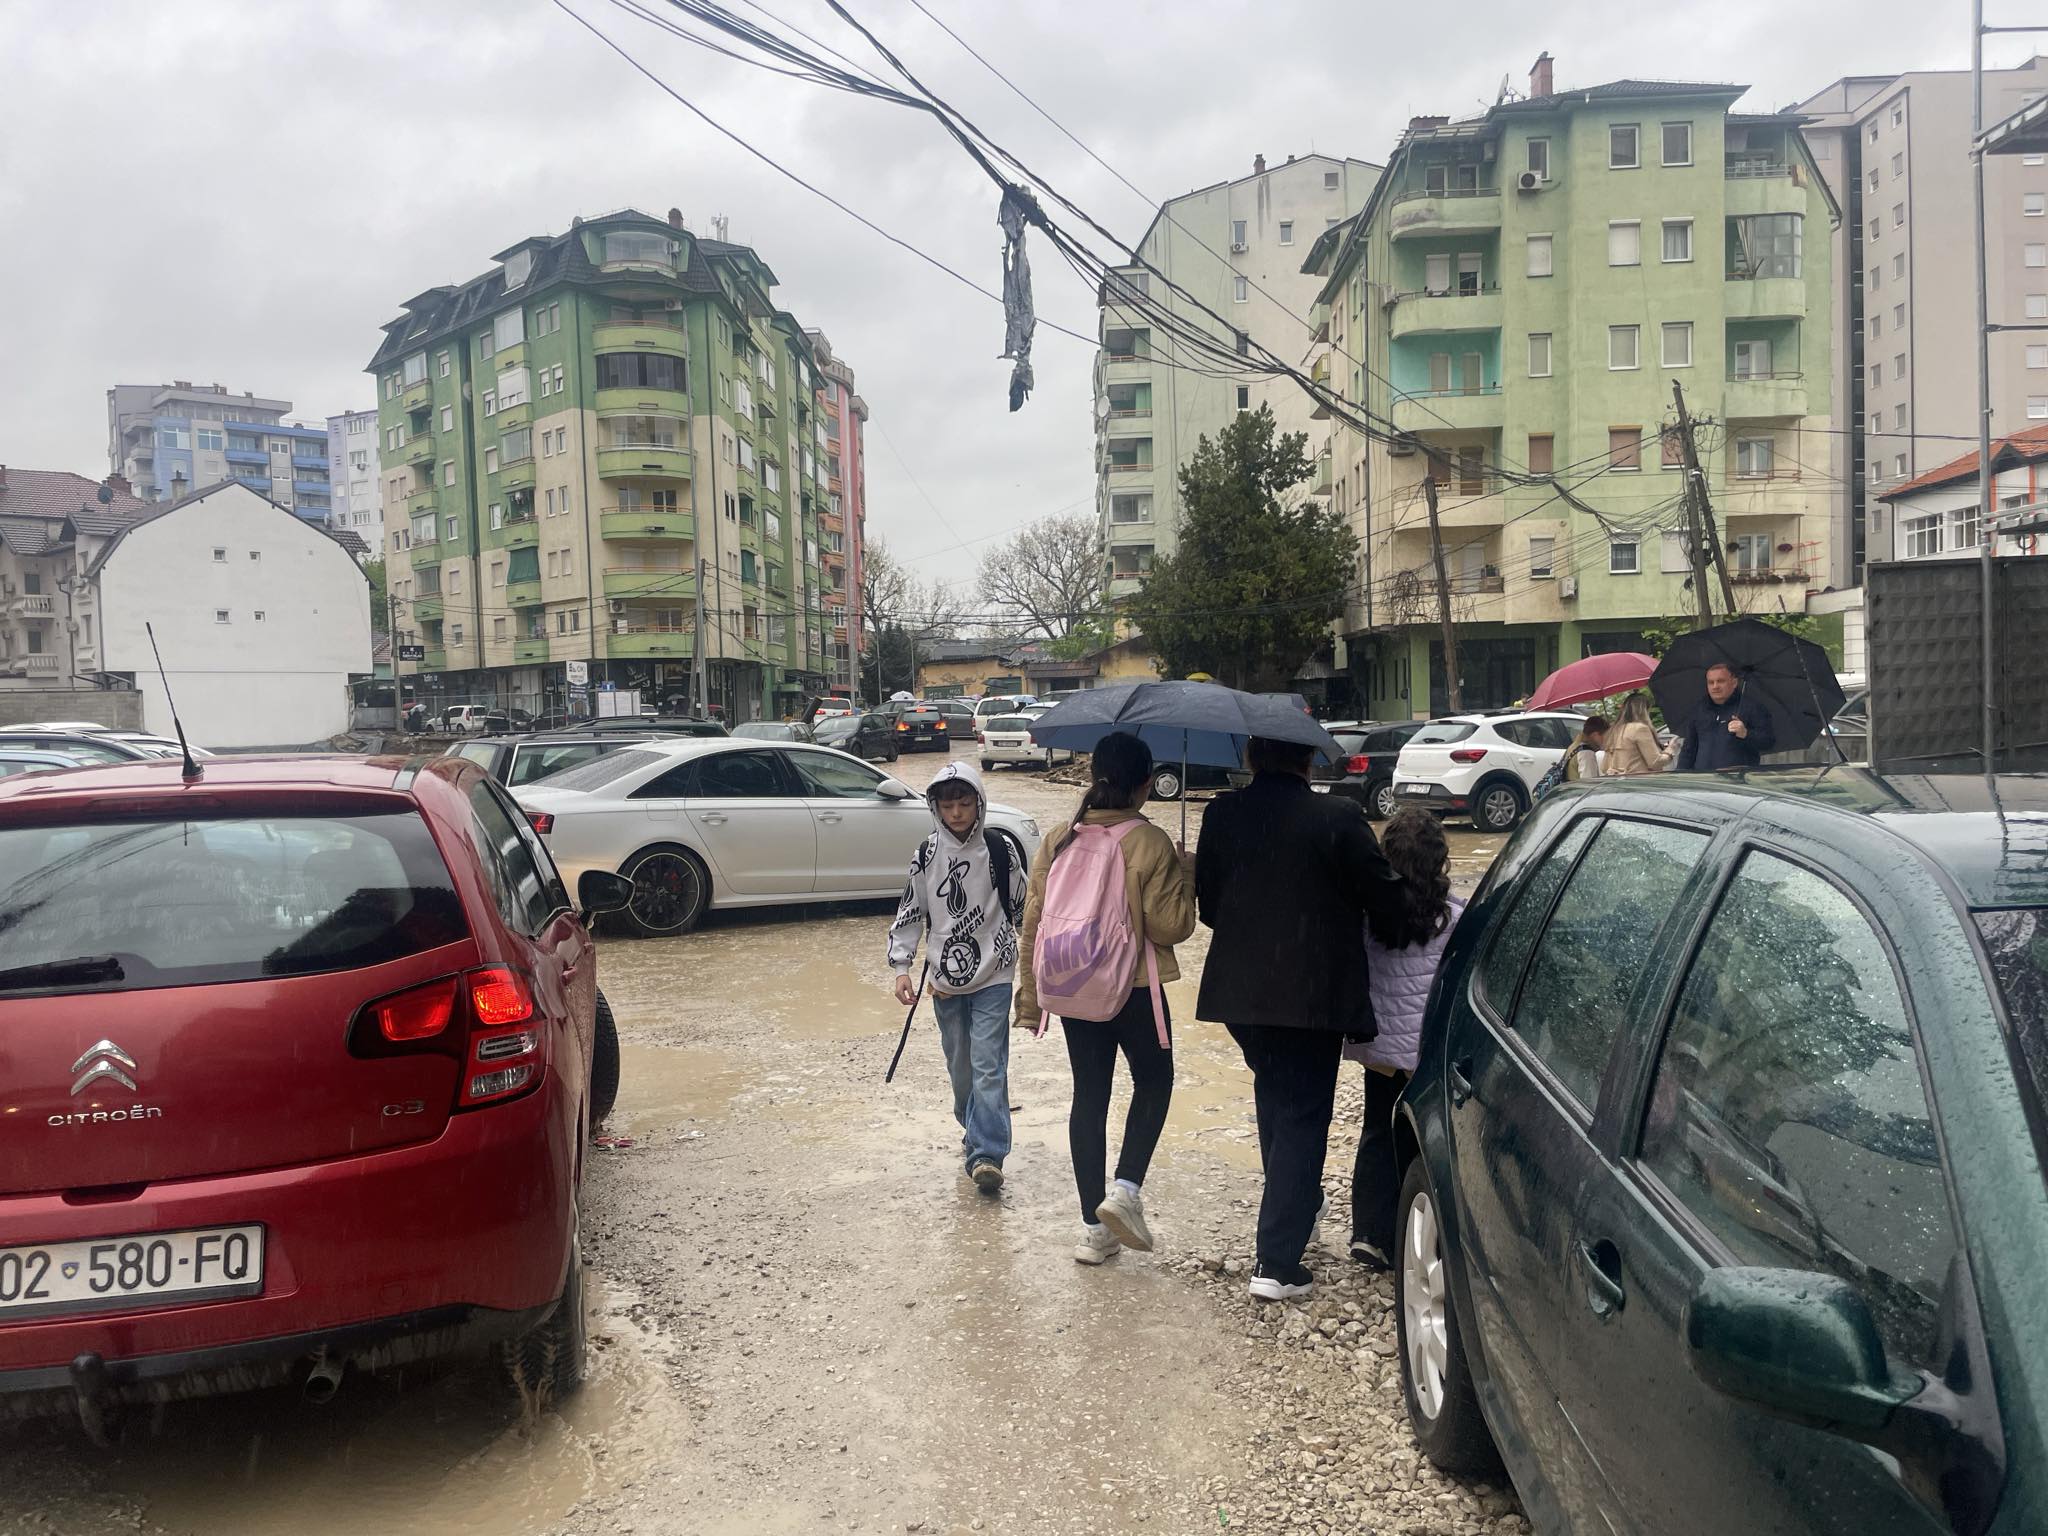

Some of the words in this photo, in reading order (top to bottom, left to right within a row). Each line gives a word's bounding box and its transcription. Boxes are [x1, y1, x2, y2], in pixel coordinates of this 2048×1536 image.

[951, 904, 982, 936] MIAMI
[962, 912, 985, 937] HEAT
[382, 1099, 425, 1116] C3
[0, 1250, 51, 1301] 02
